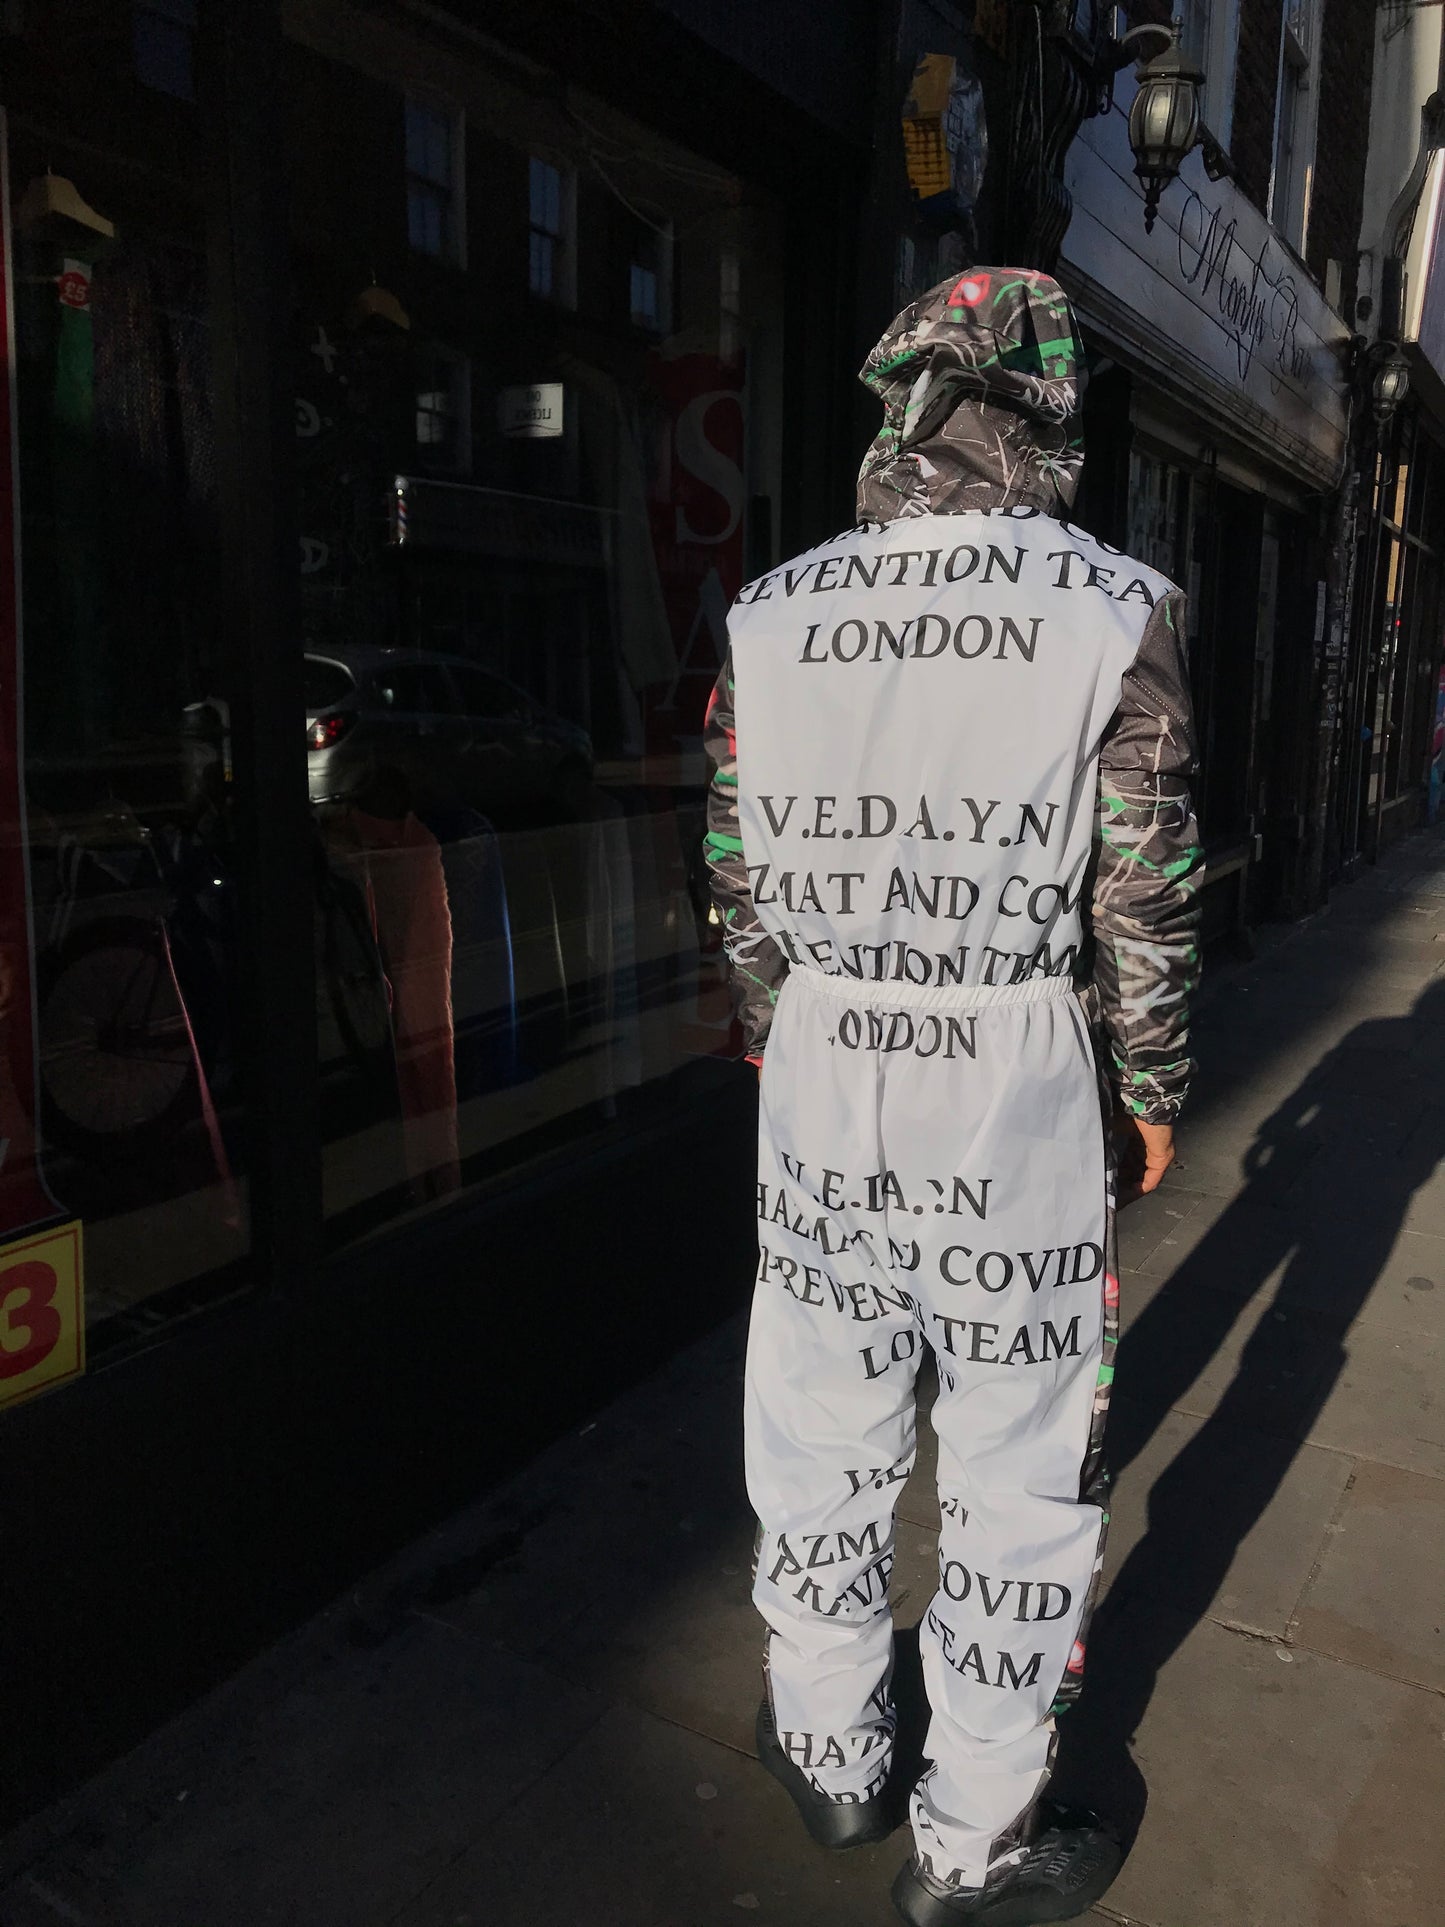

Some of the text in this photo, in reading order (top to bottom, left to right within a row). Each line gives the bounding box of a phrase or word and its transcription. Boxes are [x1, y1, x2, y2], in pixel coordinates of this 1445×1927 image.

[1046, 550, 1168, 609] TEA
[799, 614, 1044, 663] LONDON
[882, 867, 980, 920] AND
[829, 1007, 977, 1060] ONDON
[939, 1241, 1104, 1293] COVID
[933, 1315, 1082, 1366] TEAM
[938, 1556, 1072, 1622] OVID
